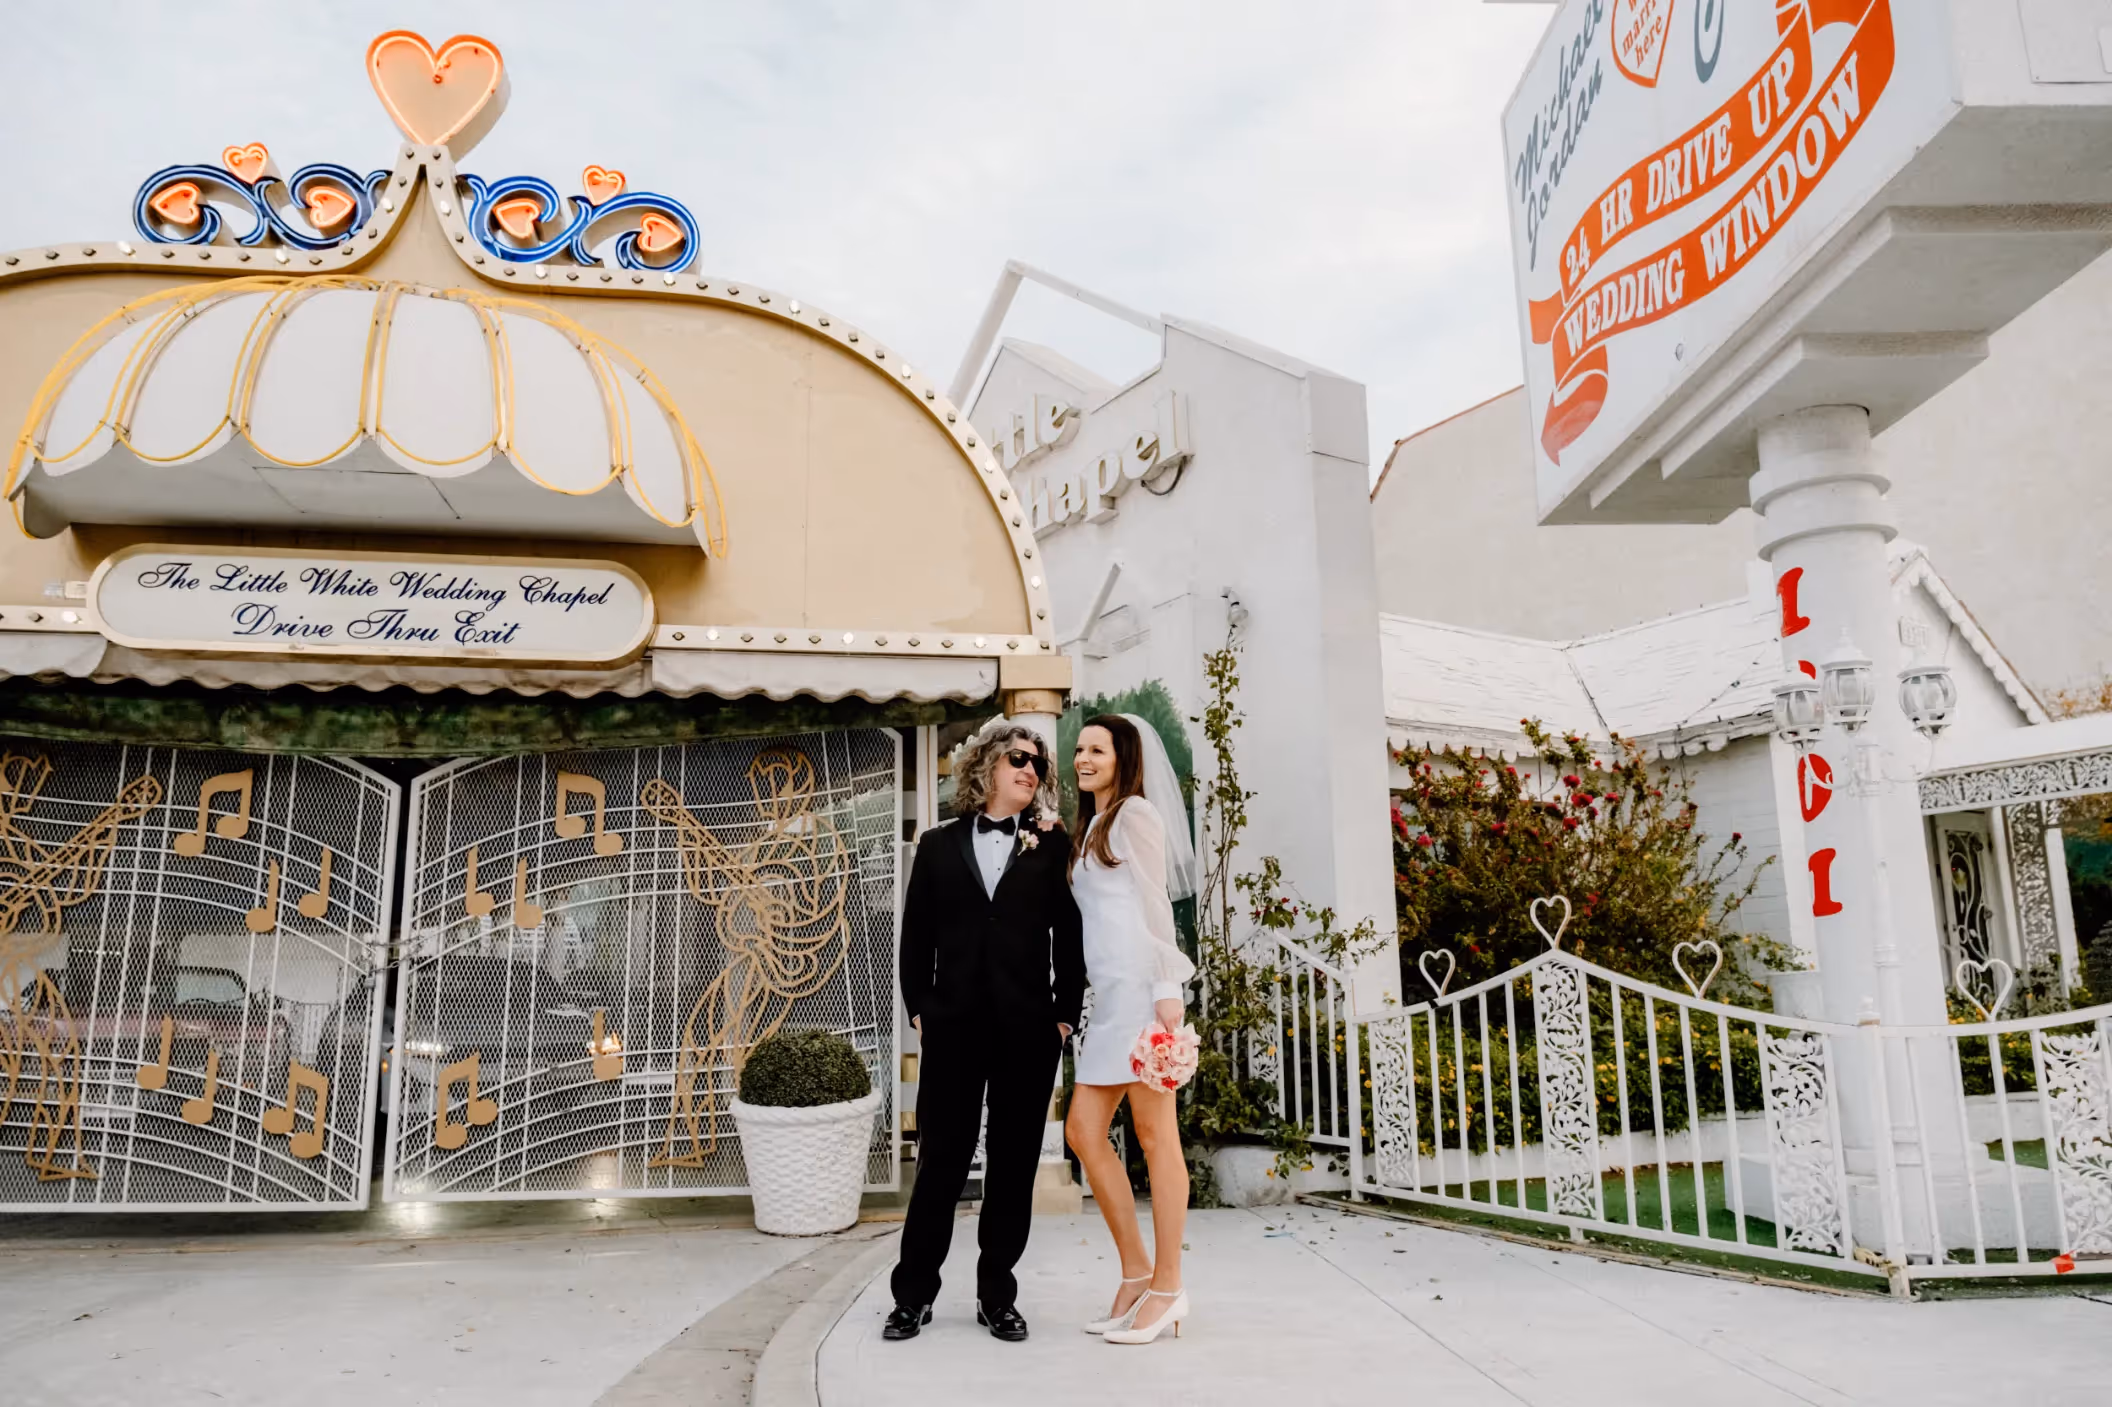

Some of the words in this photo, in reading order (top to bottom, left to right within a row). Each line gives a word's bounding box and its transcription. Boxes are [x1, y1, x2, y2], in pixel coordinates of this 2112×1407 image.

[1635, 15, 1662, 69] here
[1527, 57, 1603, 272] Jordan
[1563, 249, 1685, 358] WEDDING
[1700, 52, 1861, 282] WINDOW
[1565, 226, 1590, 286] 24
[1600, 178, 1633, 246] HR
[1647, 114, 1732, 215] DRIVE
[1747, 47, 1795, 139] UP
[1021, 389, 1188, 537] hapel
[138, 562, 200, 592] The
[210, 564, 288, 594] Little
[300, 567, 379, 598] White
[389, 570, 507, 612] Wedding
[519, 575, 614, 611] Chapel
[231, 603, 333, 639] Drive
[346, 608, 440, 642] Thru
[454, 610, 521, 644] Exit
[1777, 567, 1843, 917] 101
